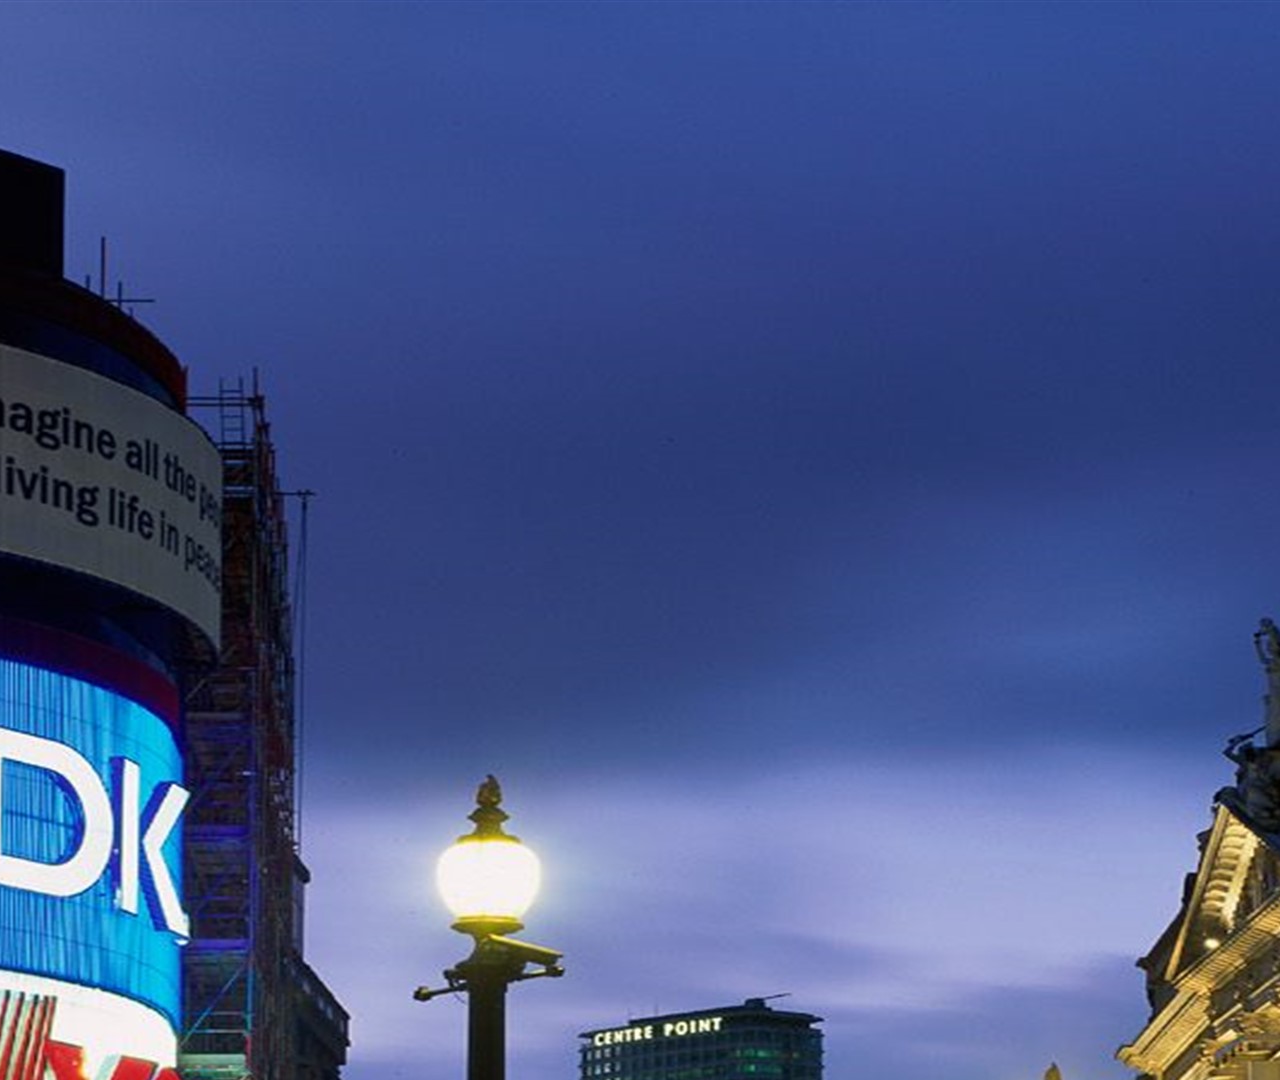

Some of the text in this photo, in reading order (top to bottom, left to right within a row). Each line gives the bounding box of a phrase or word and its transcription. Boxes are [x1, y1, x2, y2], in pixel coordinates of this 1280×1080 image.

[125, 438, 159, 481] all
[164, 452, 197, 503] the
[109, 488, 155, 540] life
[160, 511, 179, 555] in
[593, 1016, 723, 1047] CENTRE POINT
